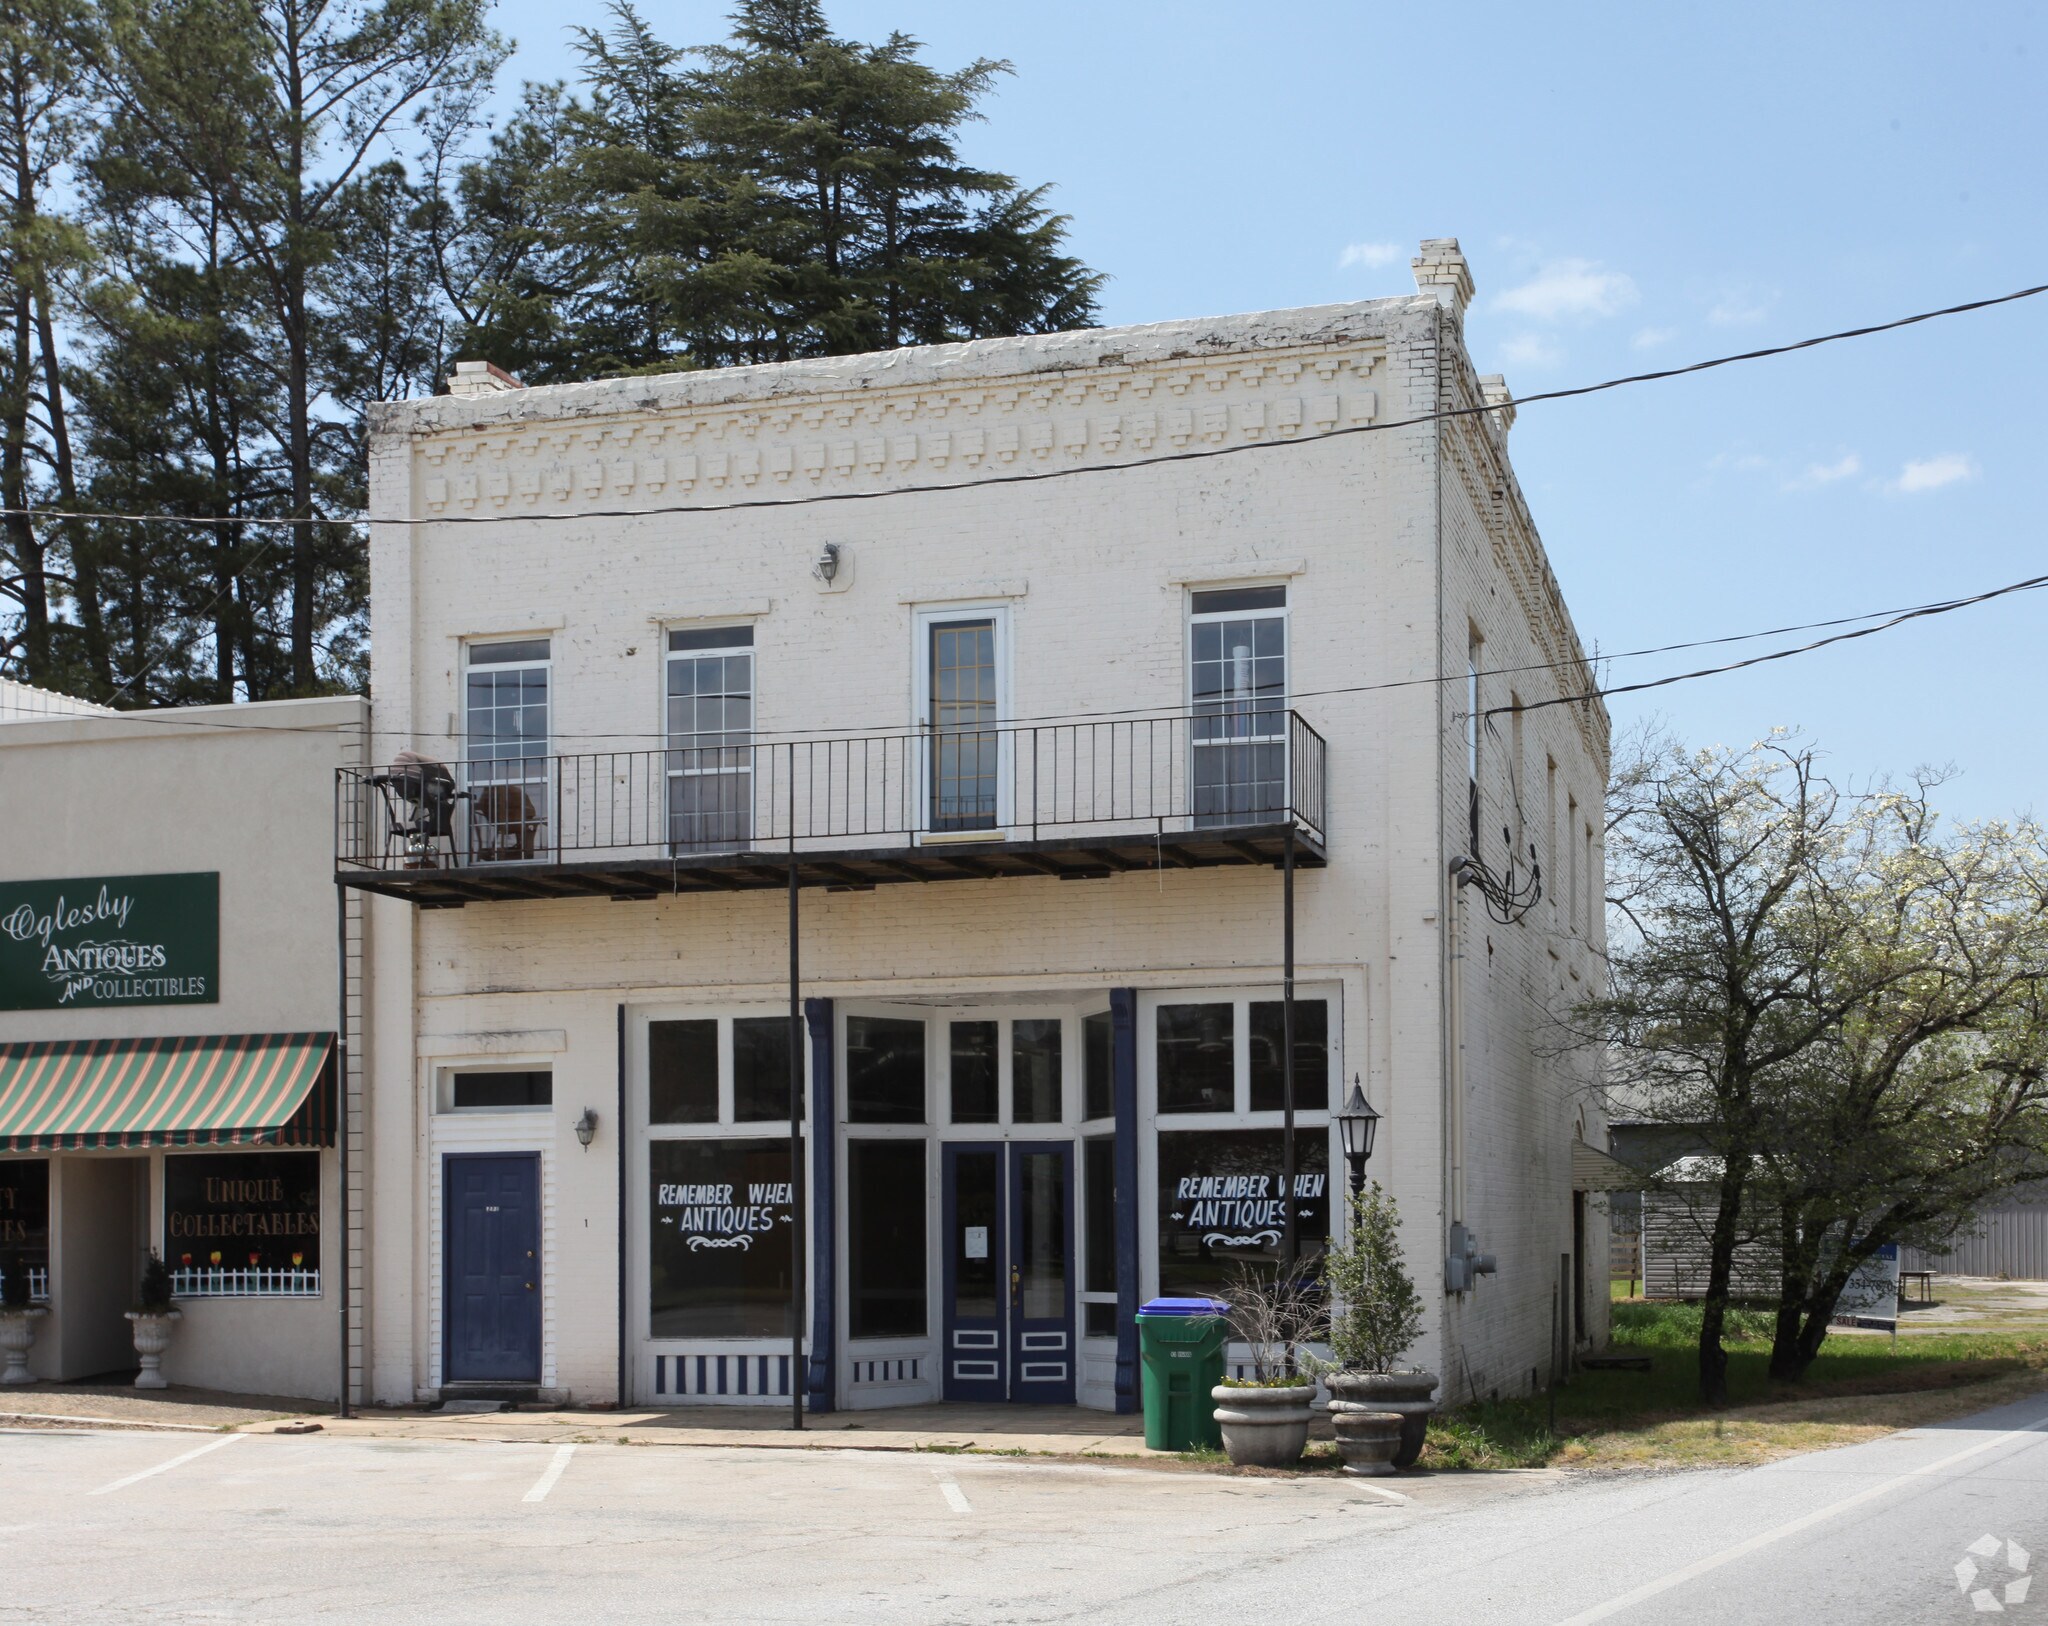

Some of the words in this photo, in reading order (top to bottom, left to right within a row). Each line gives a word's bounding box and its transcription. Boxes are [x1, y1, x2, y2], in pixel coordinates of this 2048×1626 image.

[2, 884, 135, 948] Oglesby
[41, 944, 167, 975] ANTIQUES
[58, 977, 94, 1003] AND
[93, 976, 206, 999] COLLECTIBLES
[205, 1176, 284, 1204] UNIQUE
[658, 1184, 733, 1205] REMEMBER
[1177, 1175, 1270, 1199] REMEMBER
[169, 1211, 319, 1238] COLLECTABLES
[680, 1206, 774, 1234] ANTIQUES
[1836, 1316, 1856, 1327] SALE
